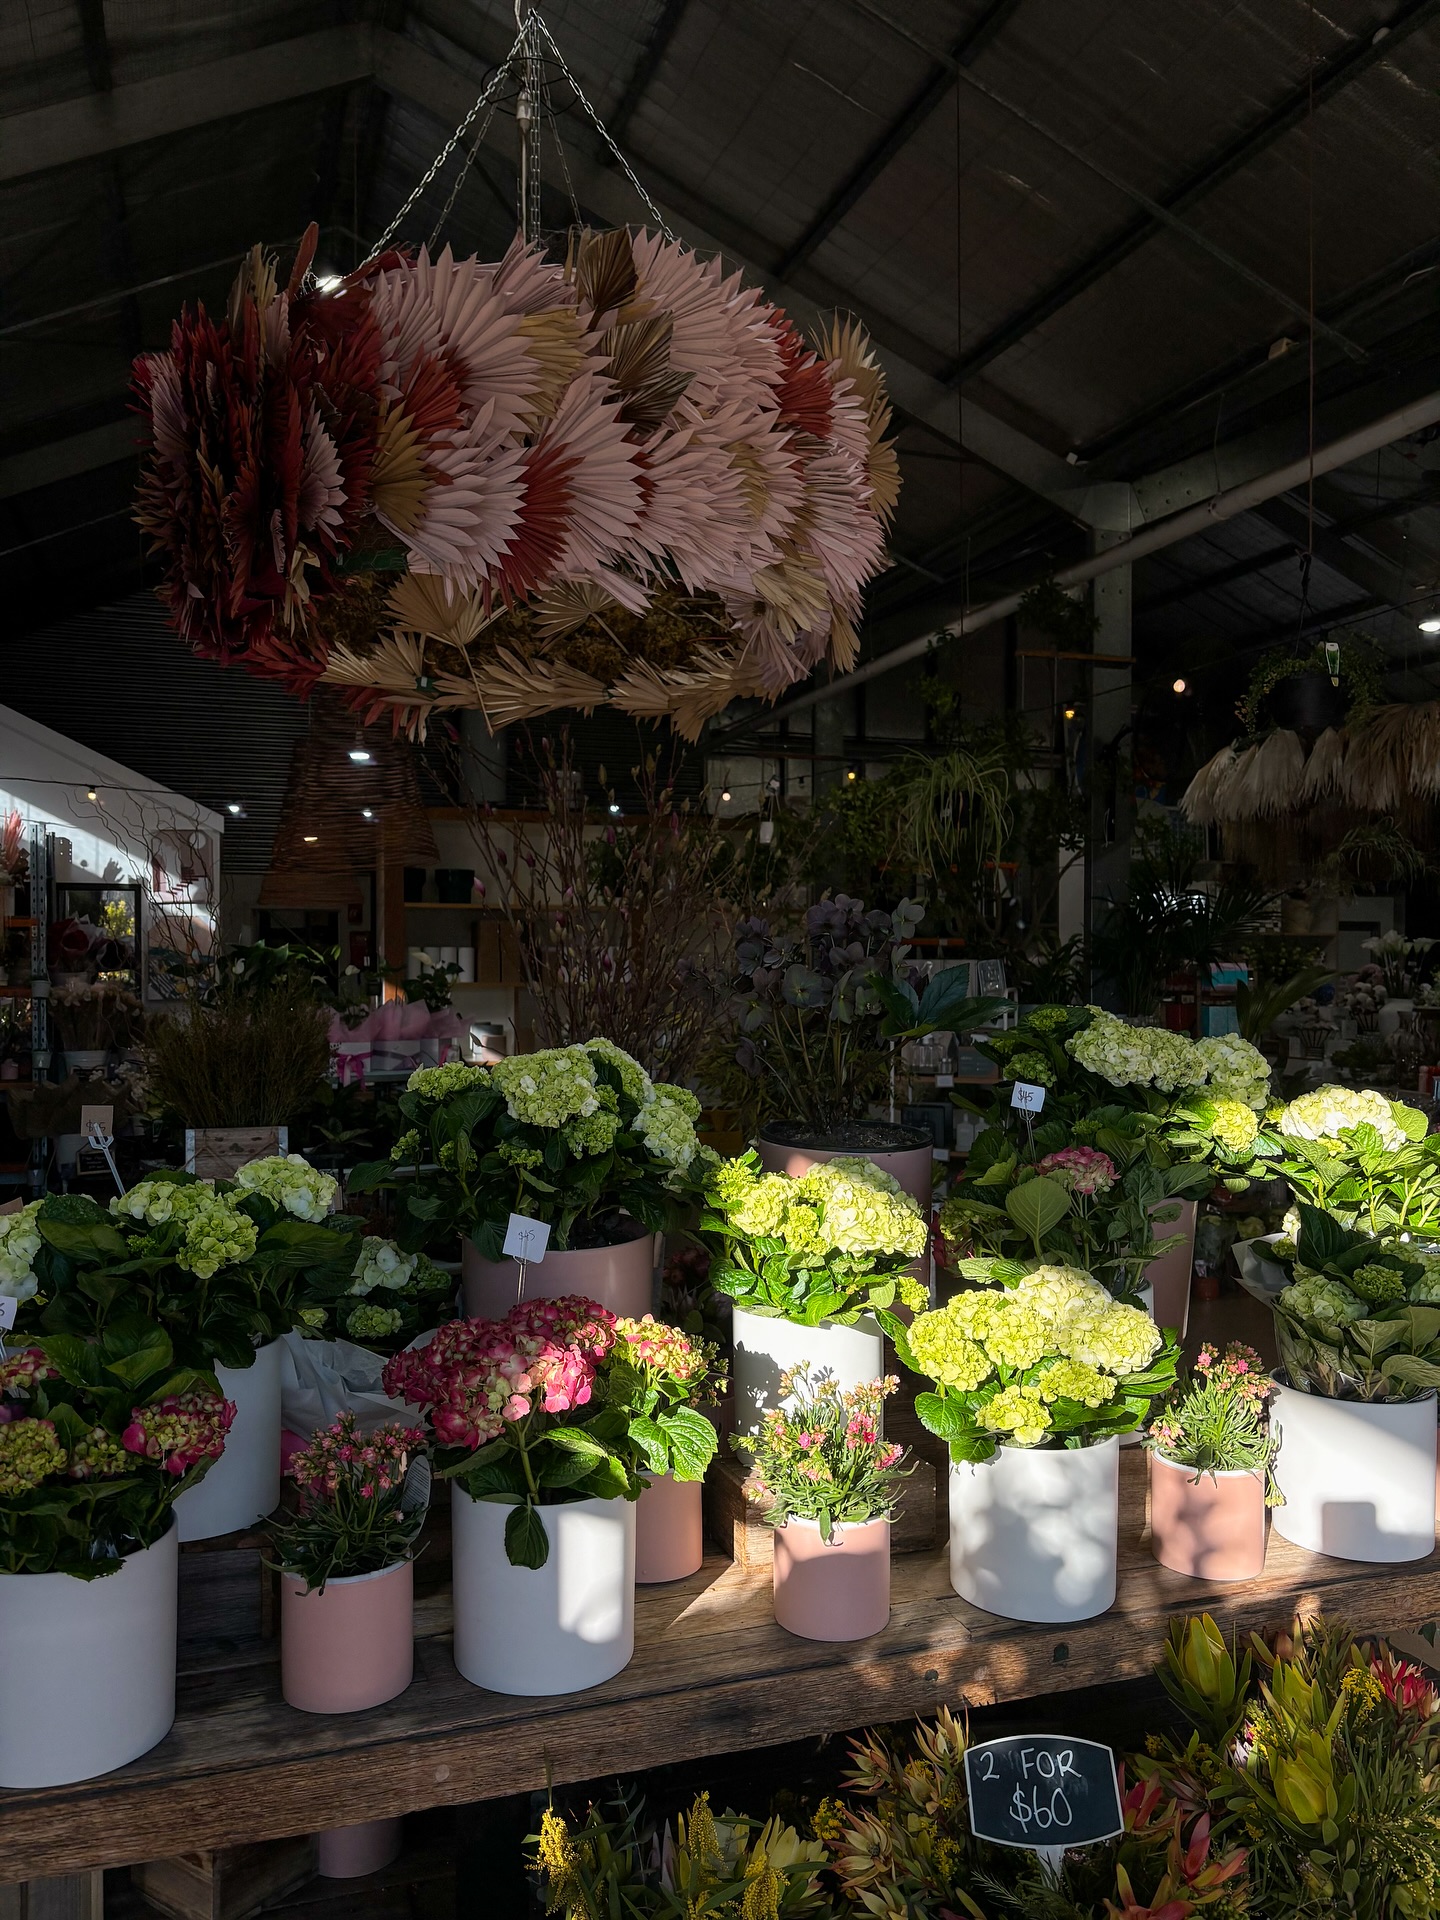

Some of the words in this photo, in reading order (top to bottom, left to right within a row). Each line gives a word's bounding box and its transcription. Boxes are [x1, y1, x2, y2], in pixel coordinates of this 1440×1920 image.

[1017, 1087, 1034, 1103] $45
[86, 1119, 106, 1132] $5
[980, 1751, 1000, 1781] 2
[1020, 1747, 1082, 1779] FOR
[1009, 1782, 1073, 1834] $60
